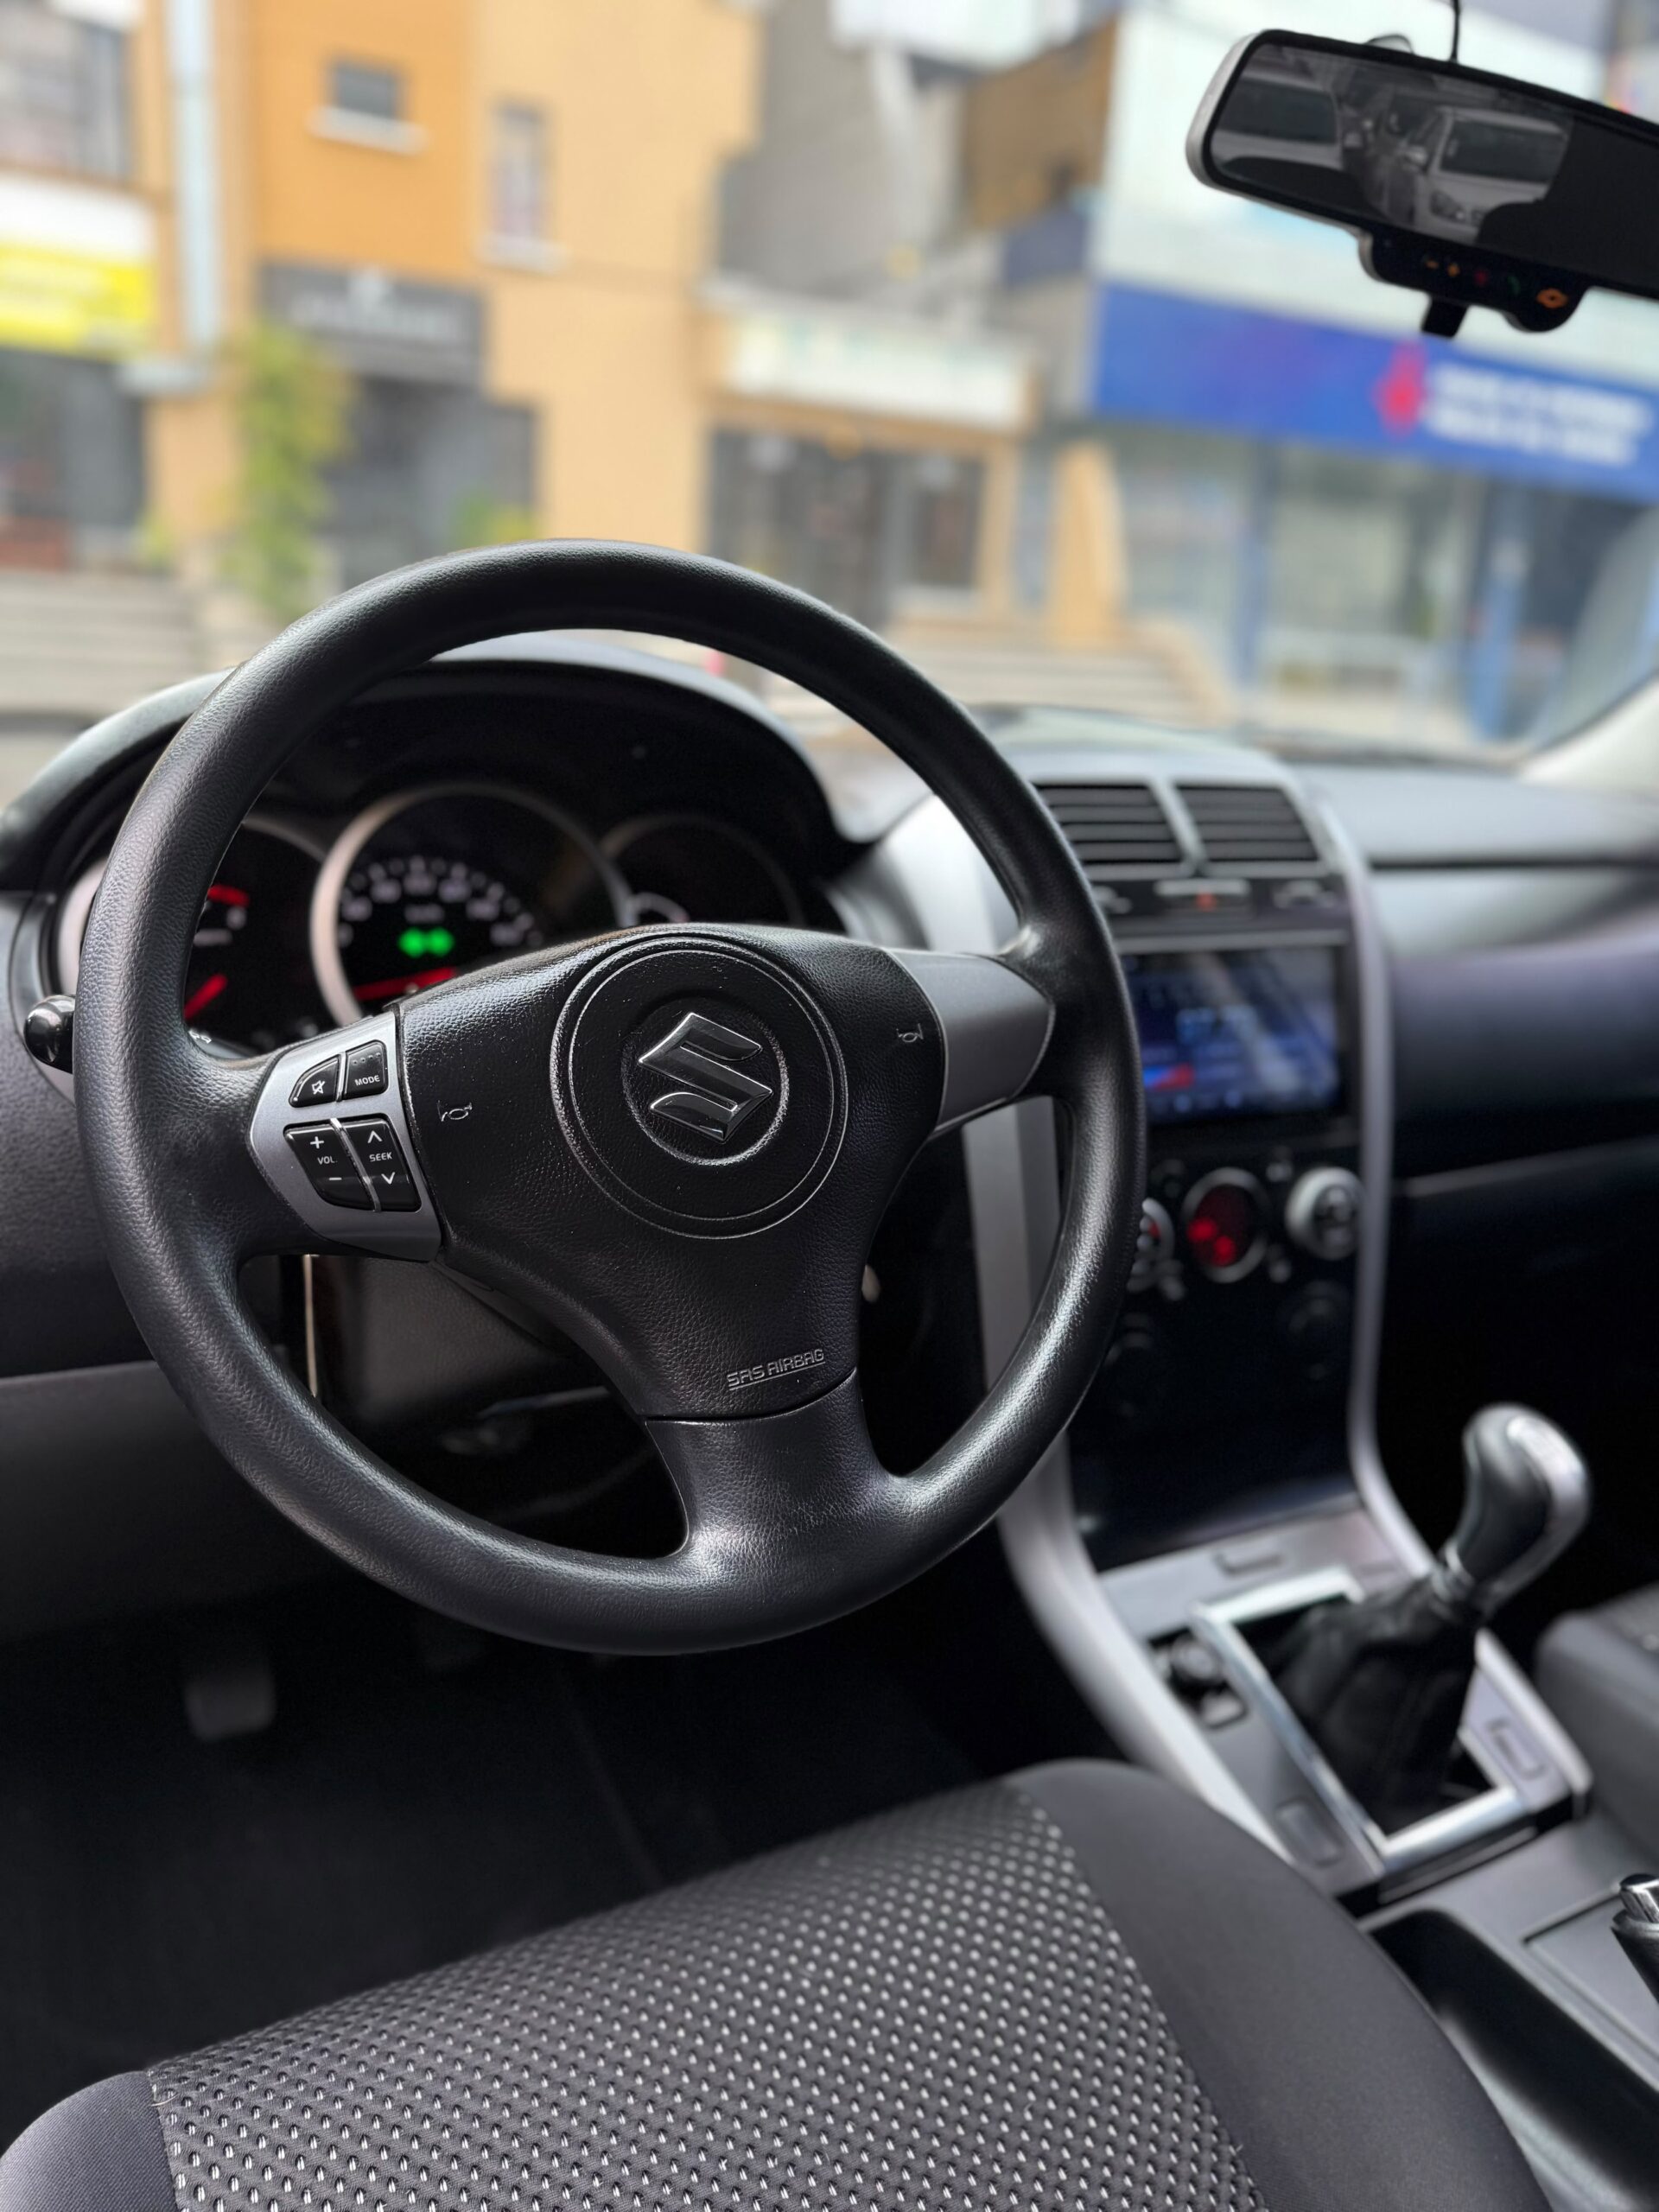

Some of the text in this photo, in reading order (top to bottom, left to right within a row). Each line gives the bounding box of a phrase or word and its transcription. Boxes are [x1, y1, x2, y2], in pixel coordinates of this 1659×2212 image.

[354, 1075, 381, 1086] MODE
[369, 1152, 393, 1162] SEEK
[767, 1349, 824, 1376] AIRBAG
